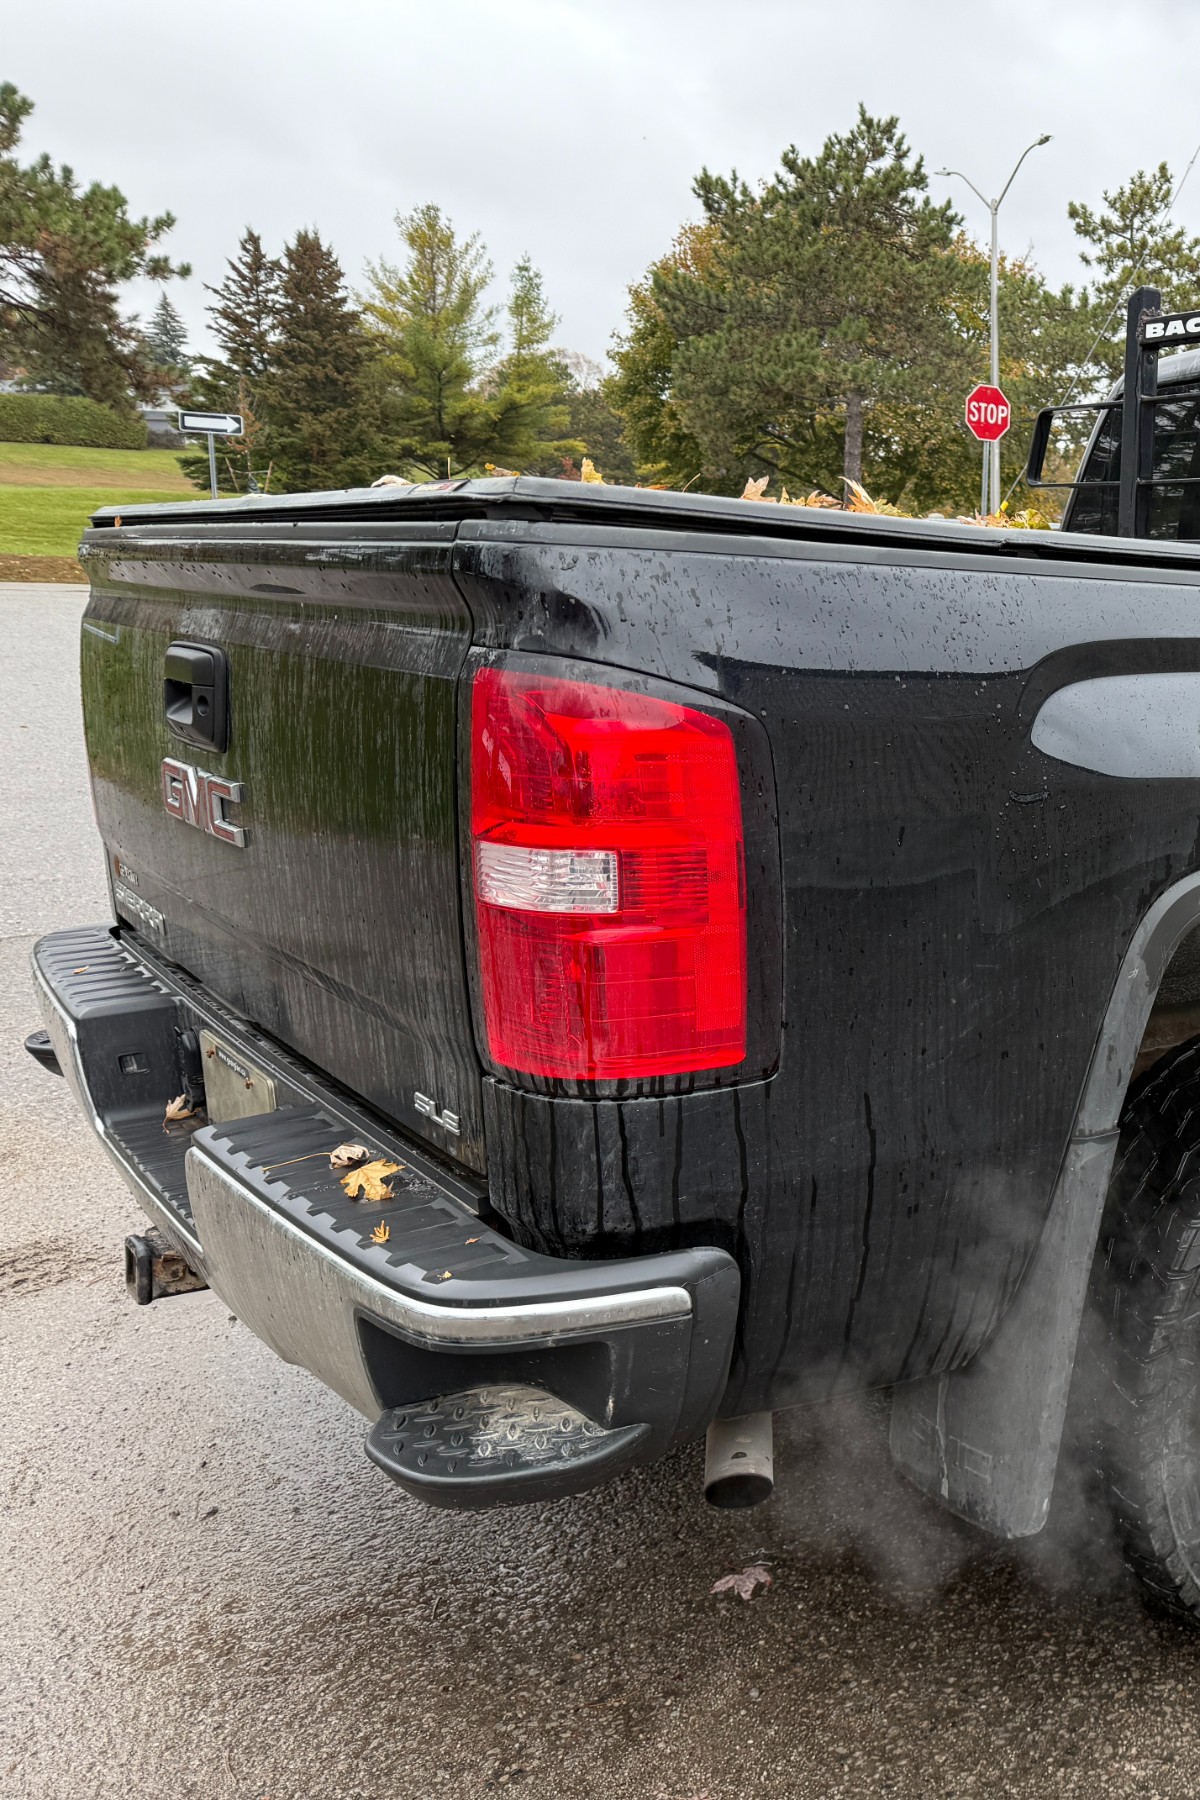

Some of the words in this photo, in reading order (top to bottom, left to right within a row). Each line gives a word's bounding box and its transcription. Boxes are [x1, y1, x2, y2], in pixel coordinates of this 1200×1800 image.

[970, 401, 1007, 425] STOP
[161, 757, 247, 848] GMC
[414, 1091, 461, 1136] SLE
